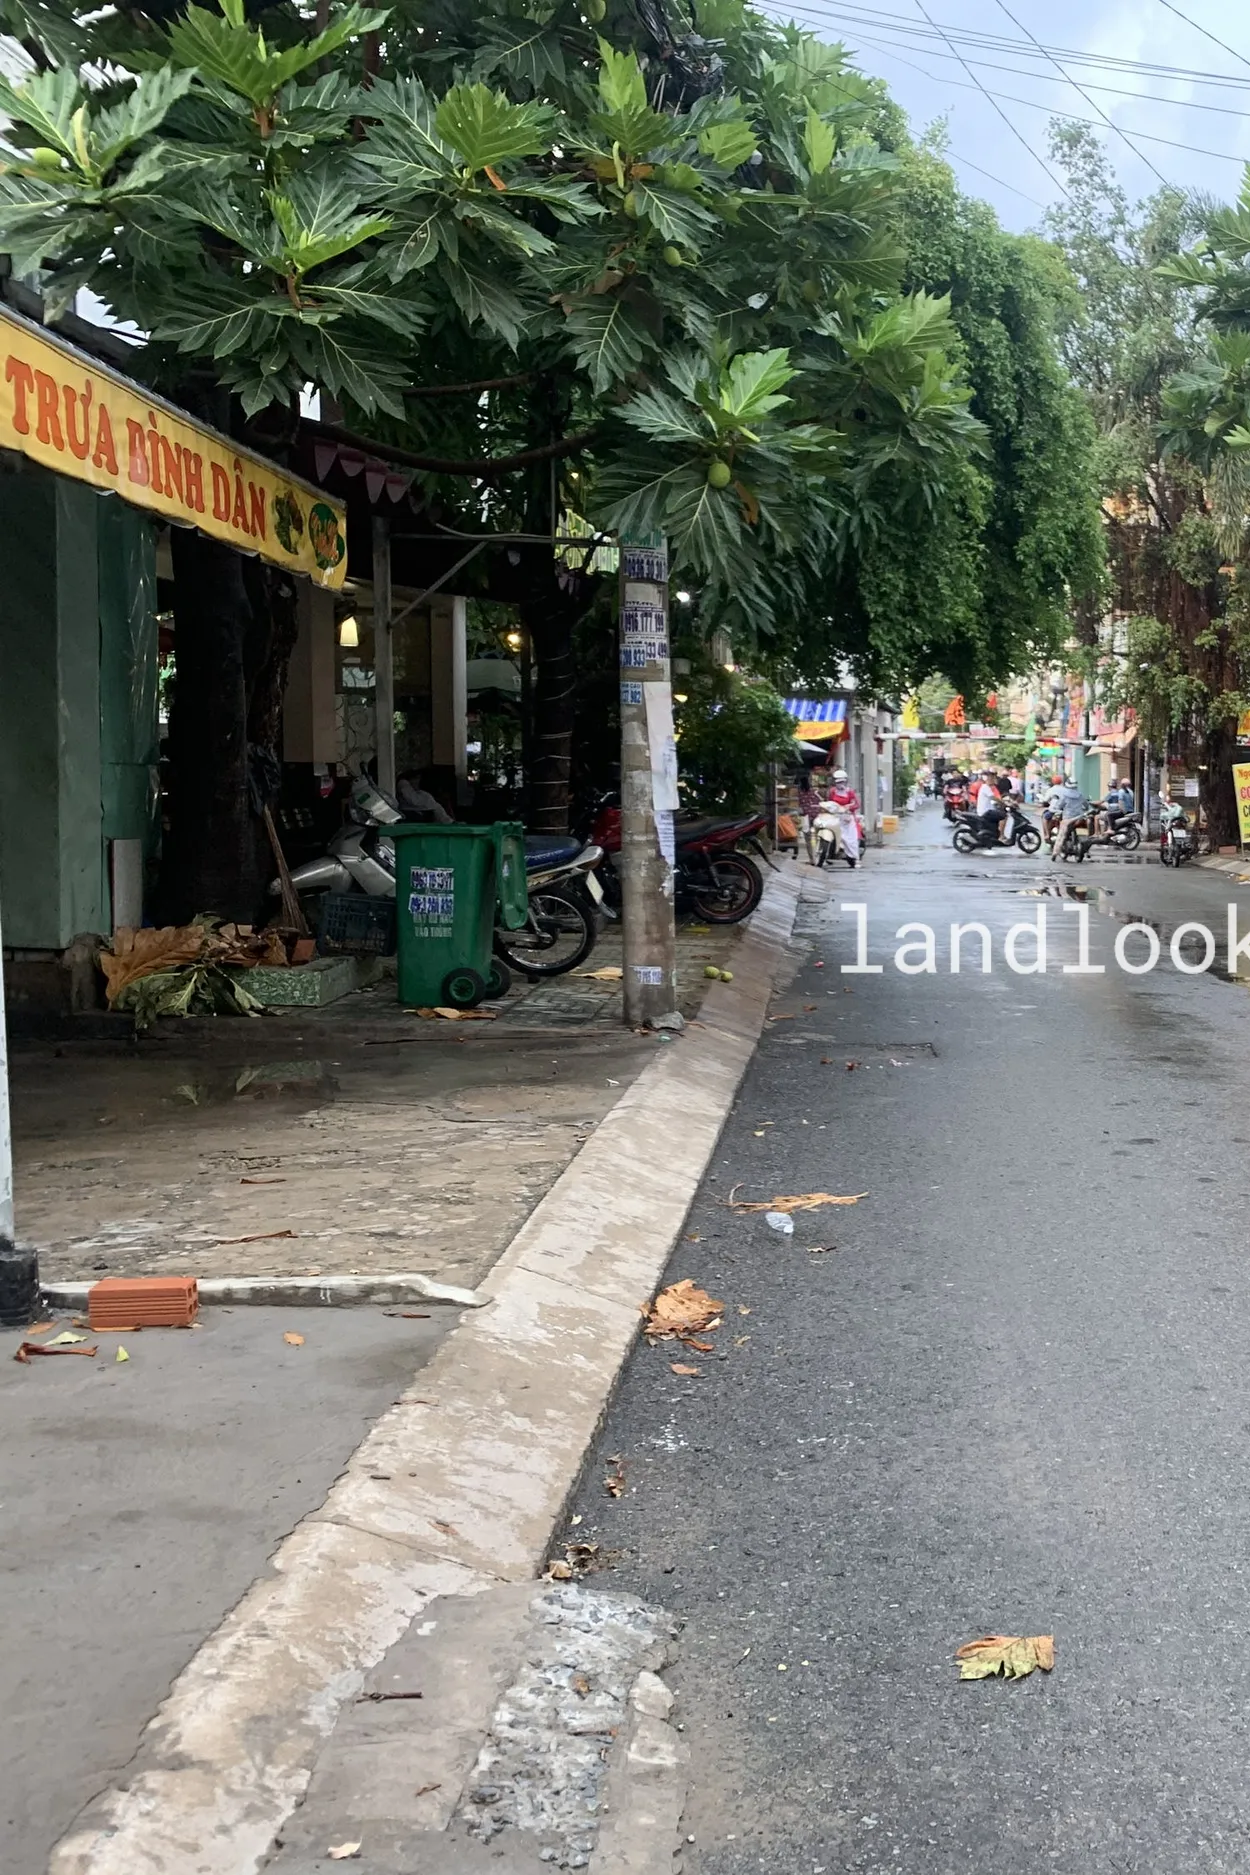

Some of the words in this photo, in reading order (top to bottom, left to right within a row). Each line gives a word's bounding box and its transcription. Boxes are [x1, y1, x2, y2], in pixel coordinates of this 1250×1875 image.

[5, 354, 119, 476] TRƯA
[126, 410, 205, 514] BÌNH
[210, 457, 266, 542] DÂN
